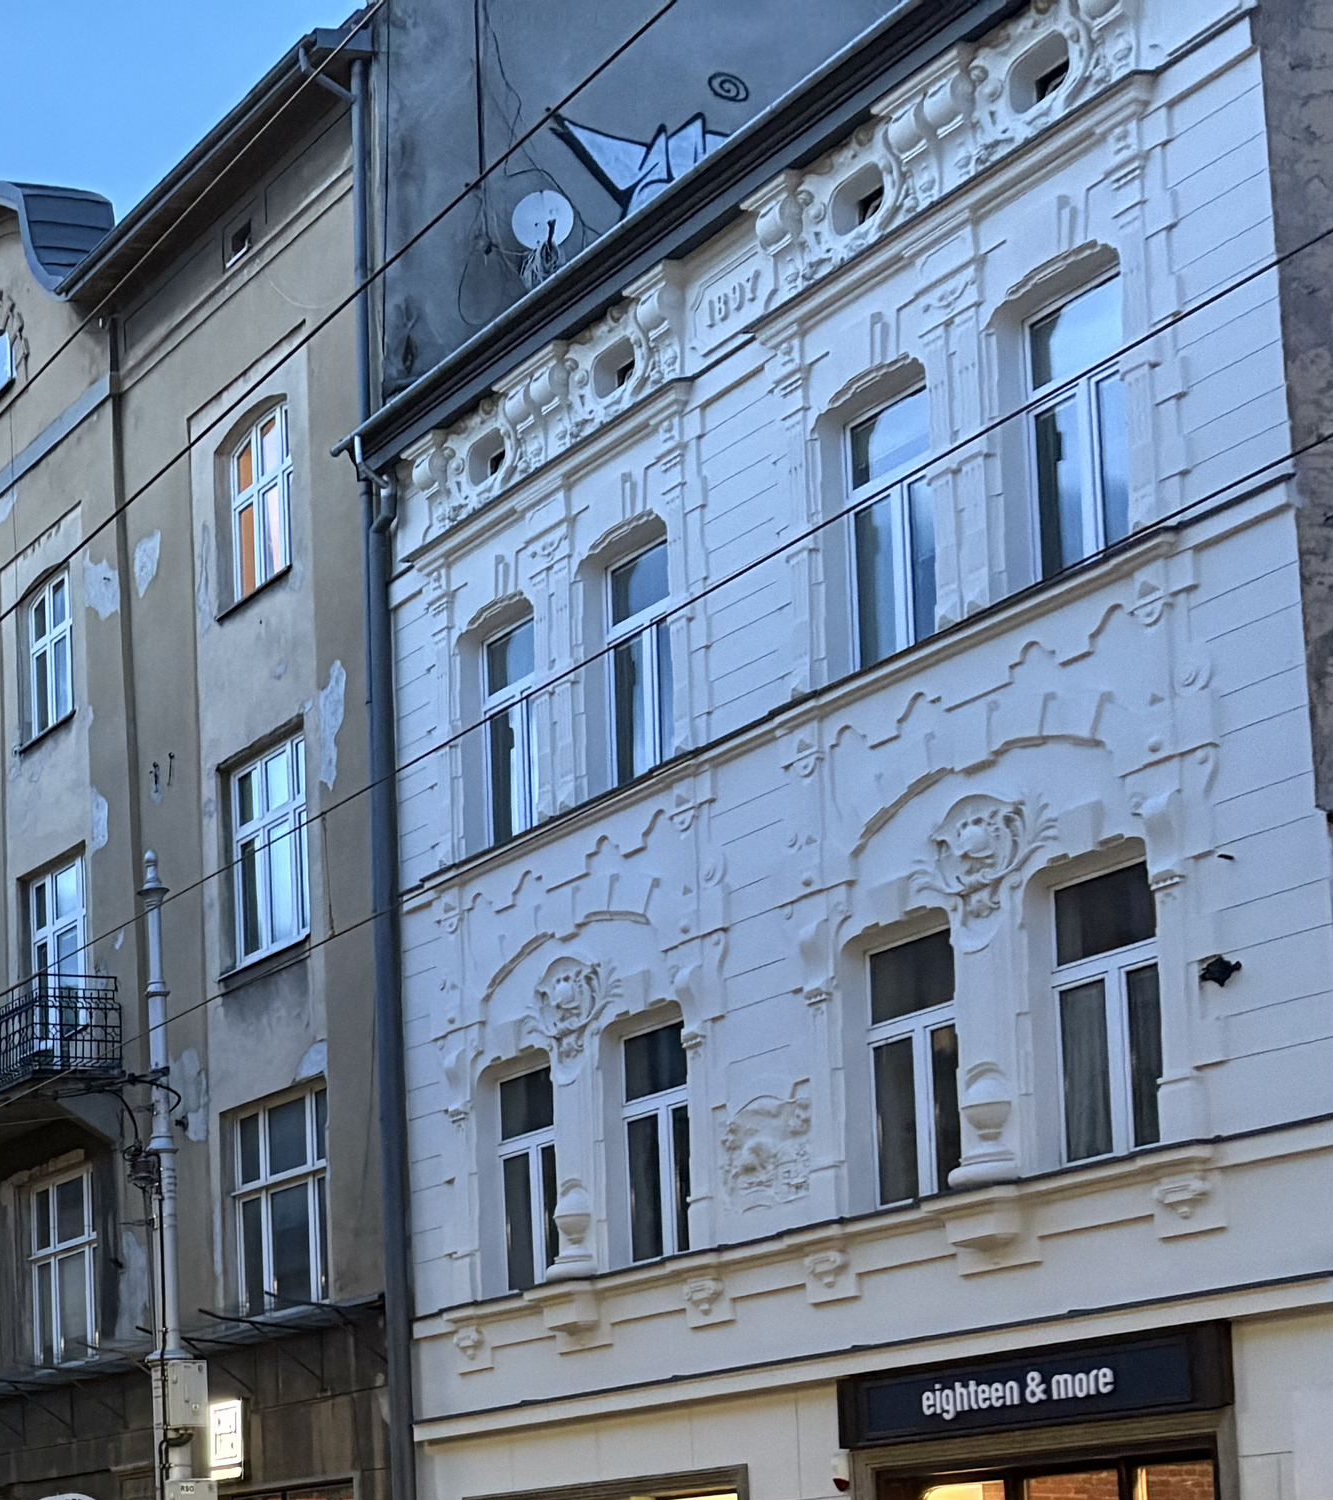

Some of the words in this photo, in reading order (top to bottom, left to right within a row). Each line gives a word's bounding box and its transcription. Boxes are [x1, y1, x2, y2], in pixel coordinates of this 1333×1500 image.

[921, 1379, 1021, 1420] eighteen
[1025, 1371, 1047, 1404] &
[1051, 1367, 1115, 1400] more
